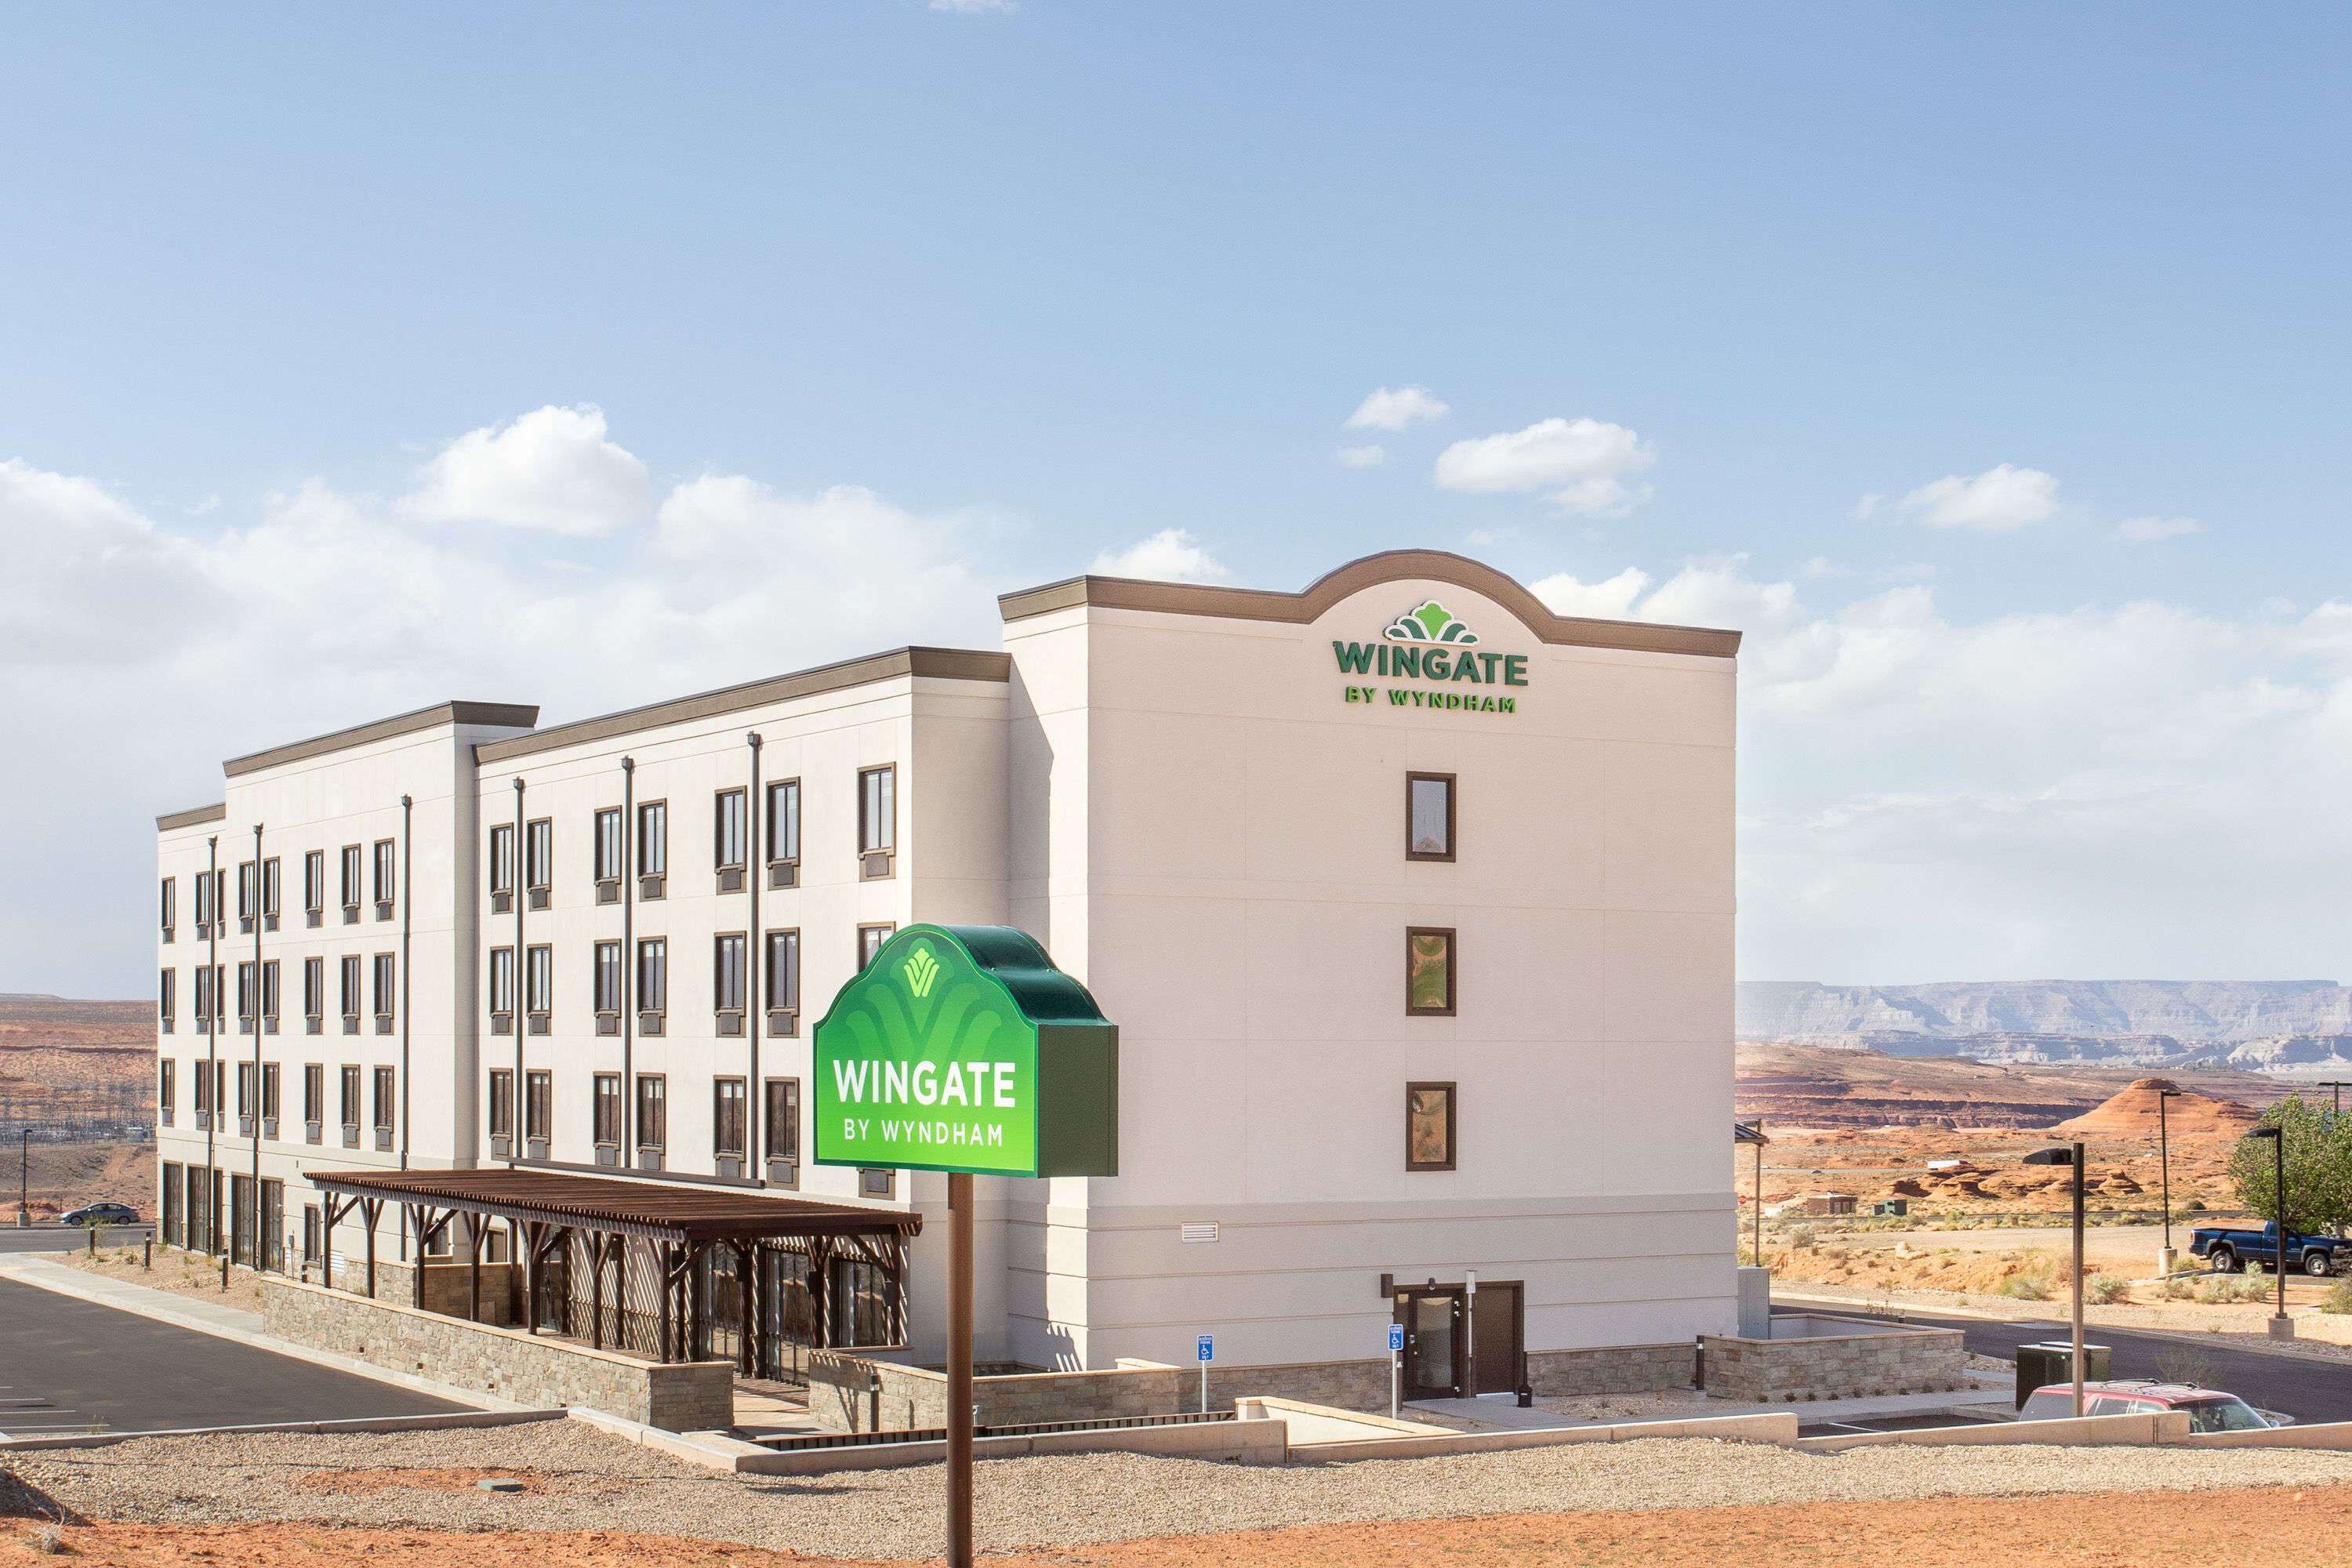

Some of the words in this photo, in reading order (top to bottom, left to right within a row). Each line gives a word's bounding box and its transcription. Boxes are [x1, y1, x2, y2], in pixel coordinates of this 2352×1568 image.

[1333, 640, 1528, 686] WINGATE
[1346, 686, 1377, 703] BY
[1388, 689, 1516, 712] WYNDHAM
[833, 1059, 1016, 1108] WINGATE
[844, 1118, 870, 1141] BY
[882, 1120, 1003, 1147] WYNDHAM
